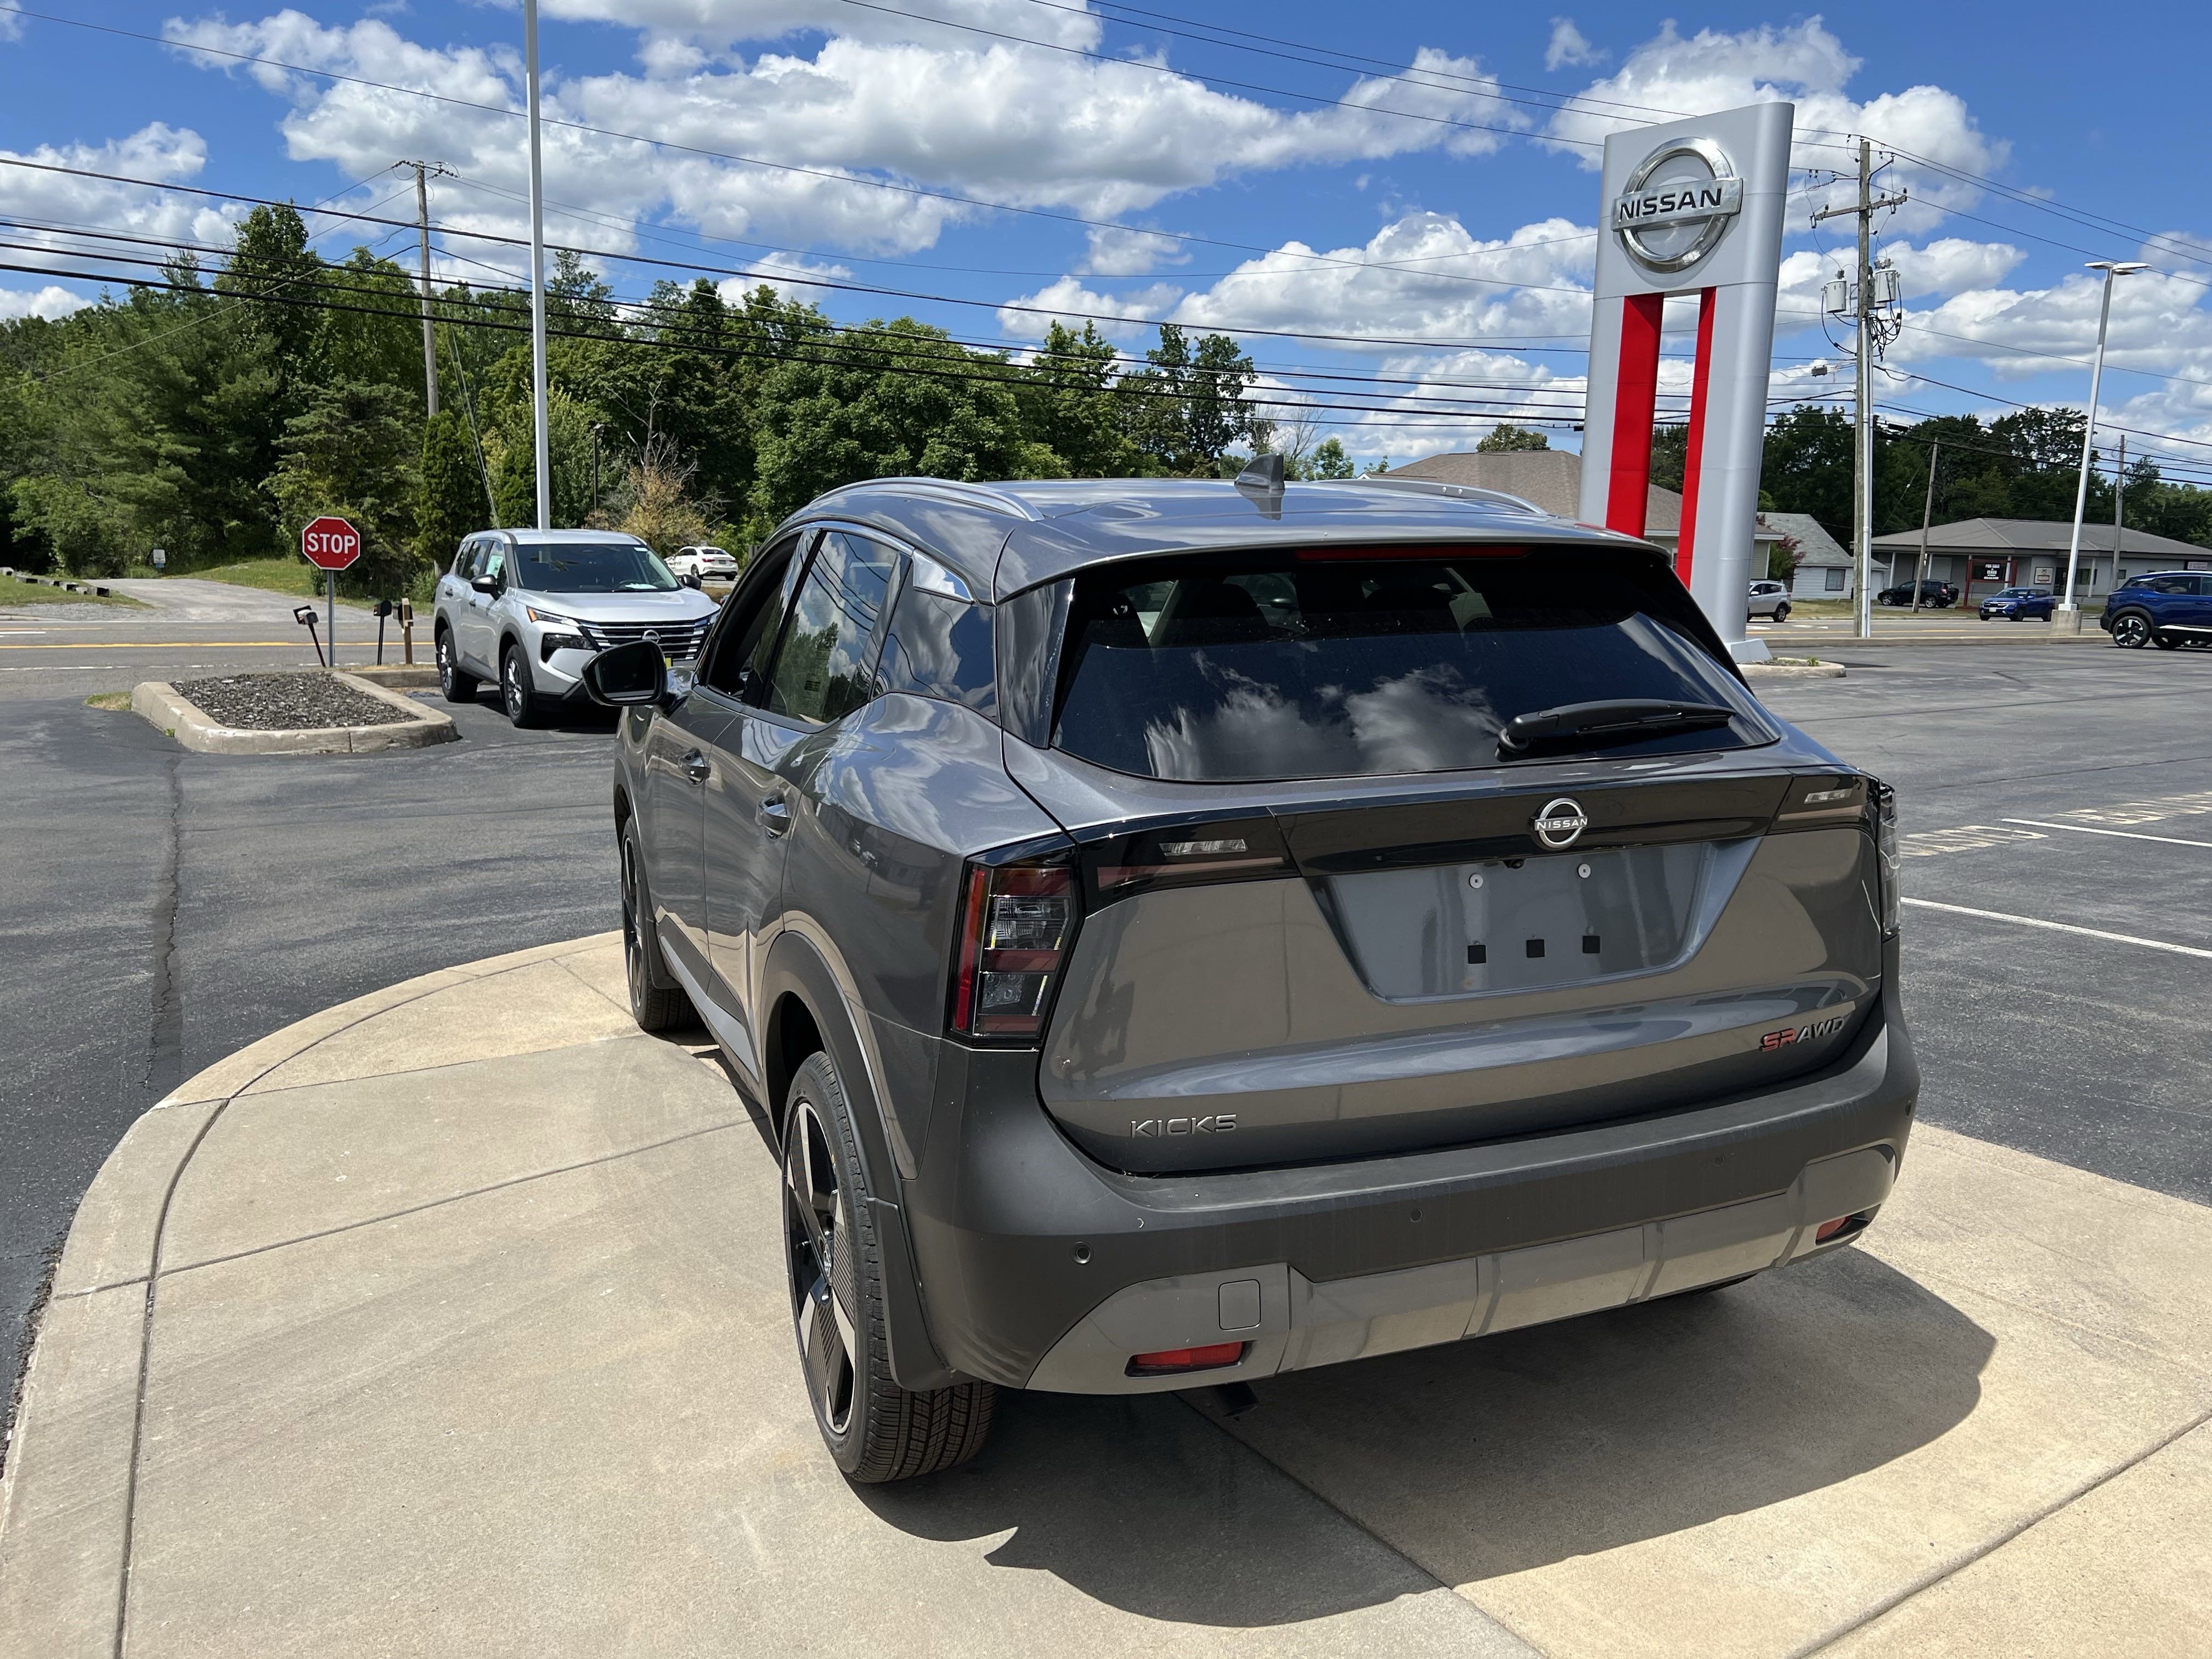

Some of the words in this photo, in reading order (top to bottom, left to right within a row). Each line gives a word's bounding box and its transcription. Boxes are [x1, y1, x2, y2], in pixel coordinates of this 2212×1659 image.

[1620, 187, 1723, 222] NISSAN
[307, 532, 357, 554] STOP
[1537, 817, 1588, 830] NISSAN
[1759, 1028, 1796, 1052] SR
[1796, 1016, 1845, 1043] AWD
[1130, 1113, 1237, 1138] KICKS
